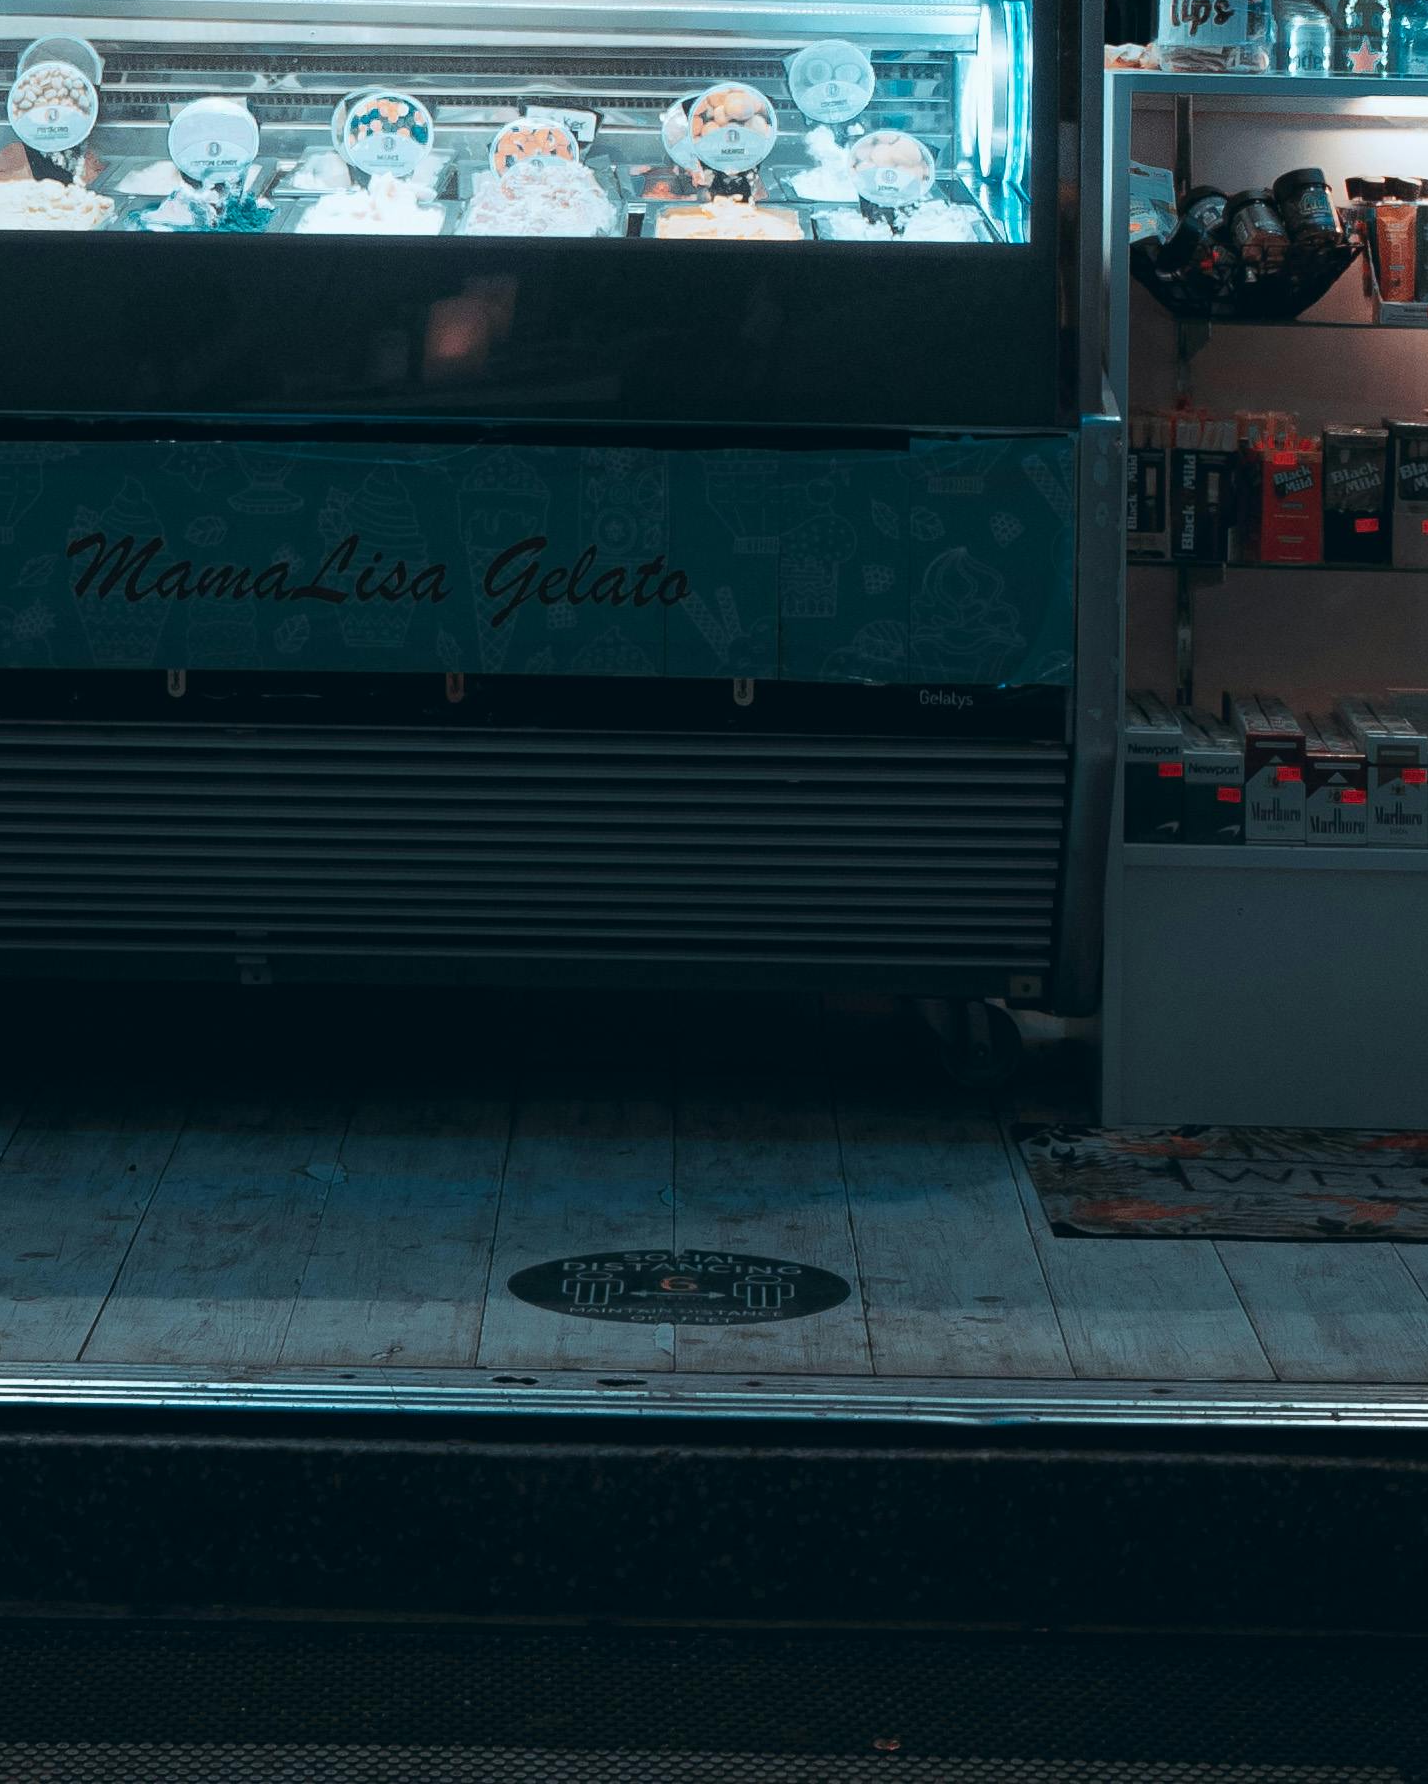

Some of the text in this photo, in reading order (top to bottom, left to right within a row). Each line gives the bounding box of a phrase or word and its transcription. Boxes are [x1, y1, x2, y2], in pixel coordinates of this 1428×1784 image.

[66, 530, 696, 629] MamaLisa Gelato
[918, 688, 974, 711] Gelatys
[1127, 743, 1180, 757] Newport
[1188, 764, 1240, 776] Newport
[562, 1261, 804, 1276] DISTANCING
